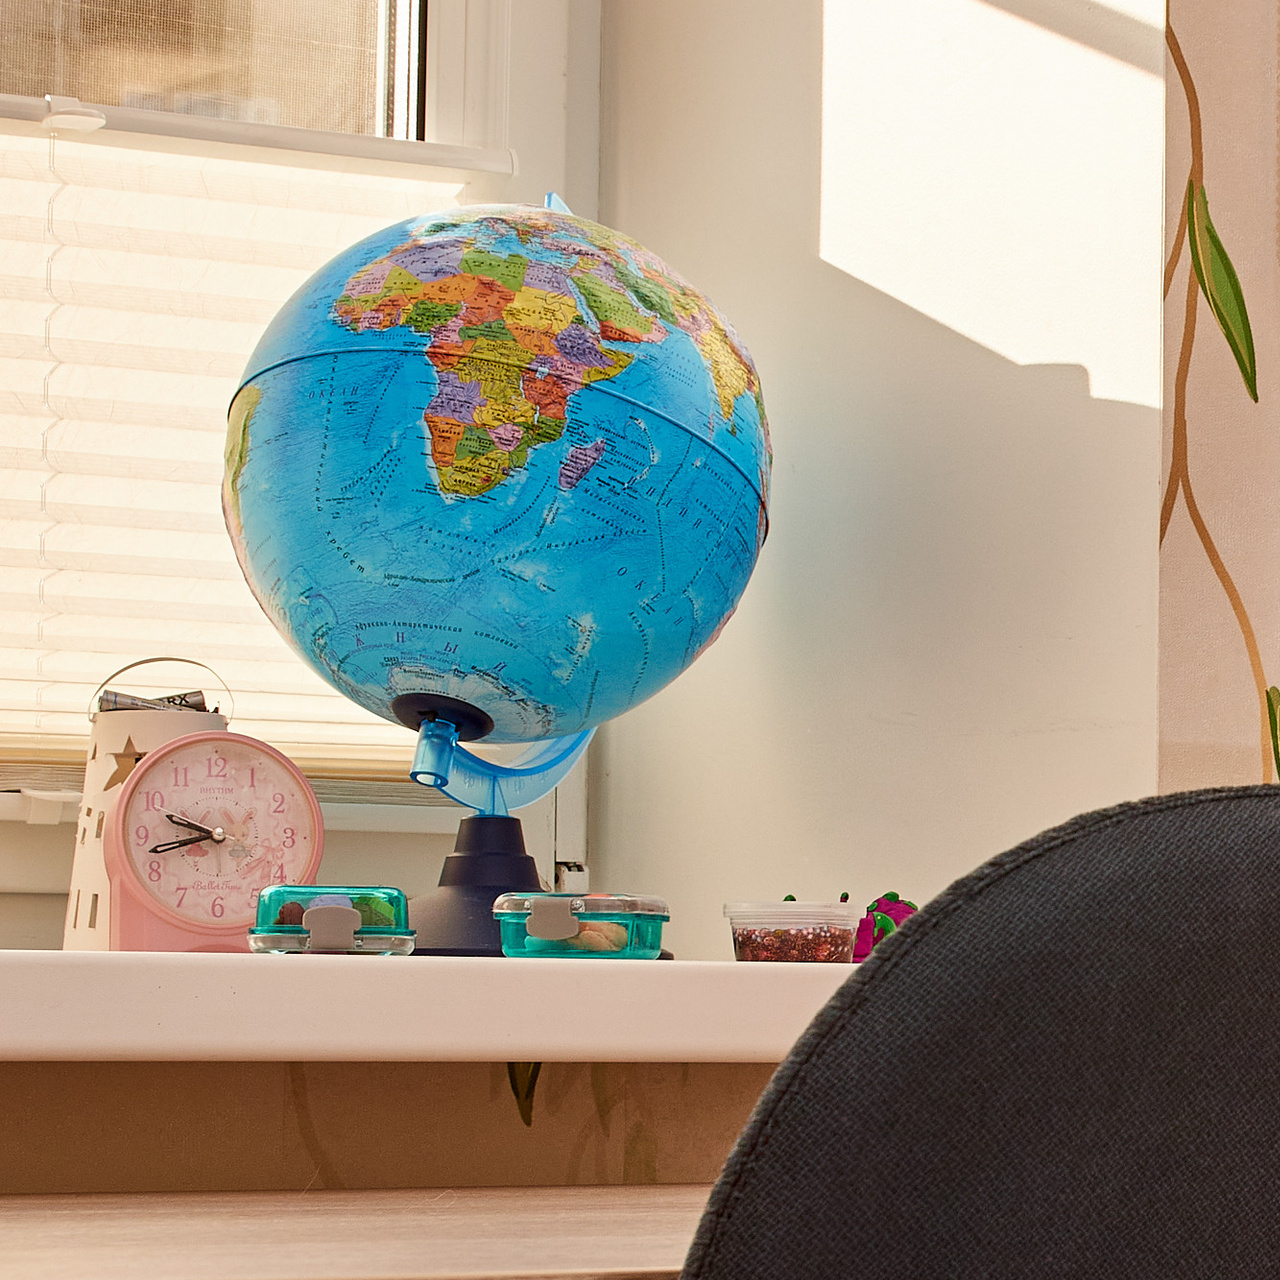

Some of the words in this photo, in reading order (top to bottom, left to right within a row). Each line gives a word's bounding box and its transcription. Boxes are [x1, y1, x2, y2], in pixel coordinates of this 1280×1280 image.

[325, 529, 365, 573] хребет
[172, 767, 190, 787] 11
[206, 757, 228, 778] 12
[249, 768, 256, 788] 1
[143, 791, 165, 811] 10
[200, 786, 234, 795] RHYTHM
[272, 793, 285, 814] 2
[135, 825, 149, 847] 9
[283, 827, 296, 849] 3
[149, 860, 162, 882] 8
[273, 863, 287, 884] 4
[191, 880, 221, 891] Ballet
[174, 886, 188, 908] 7
[211, 896, 225, 918] 6
